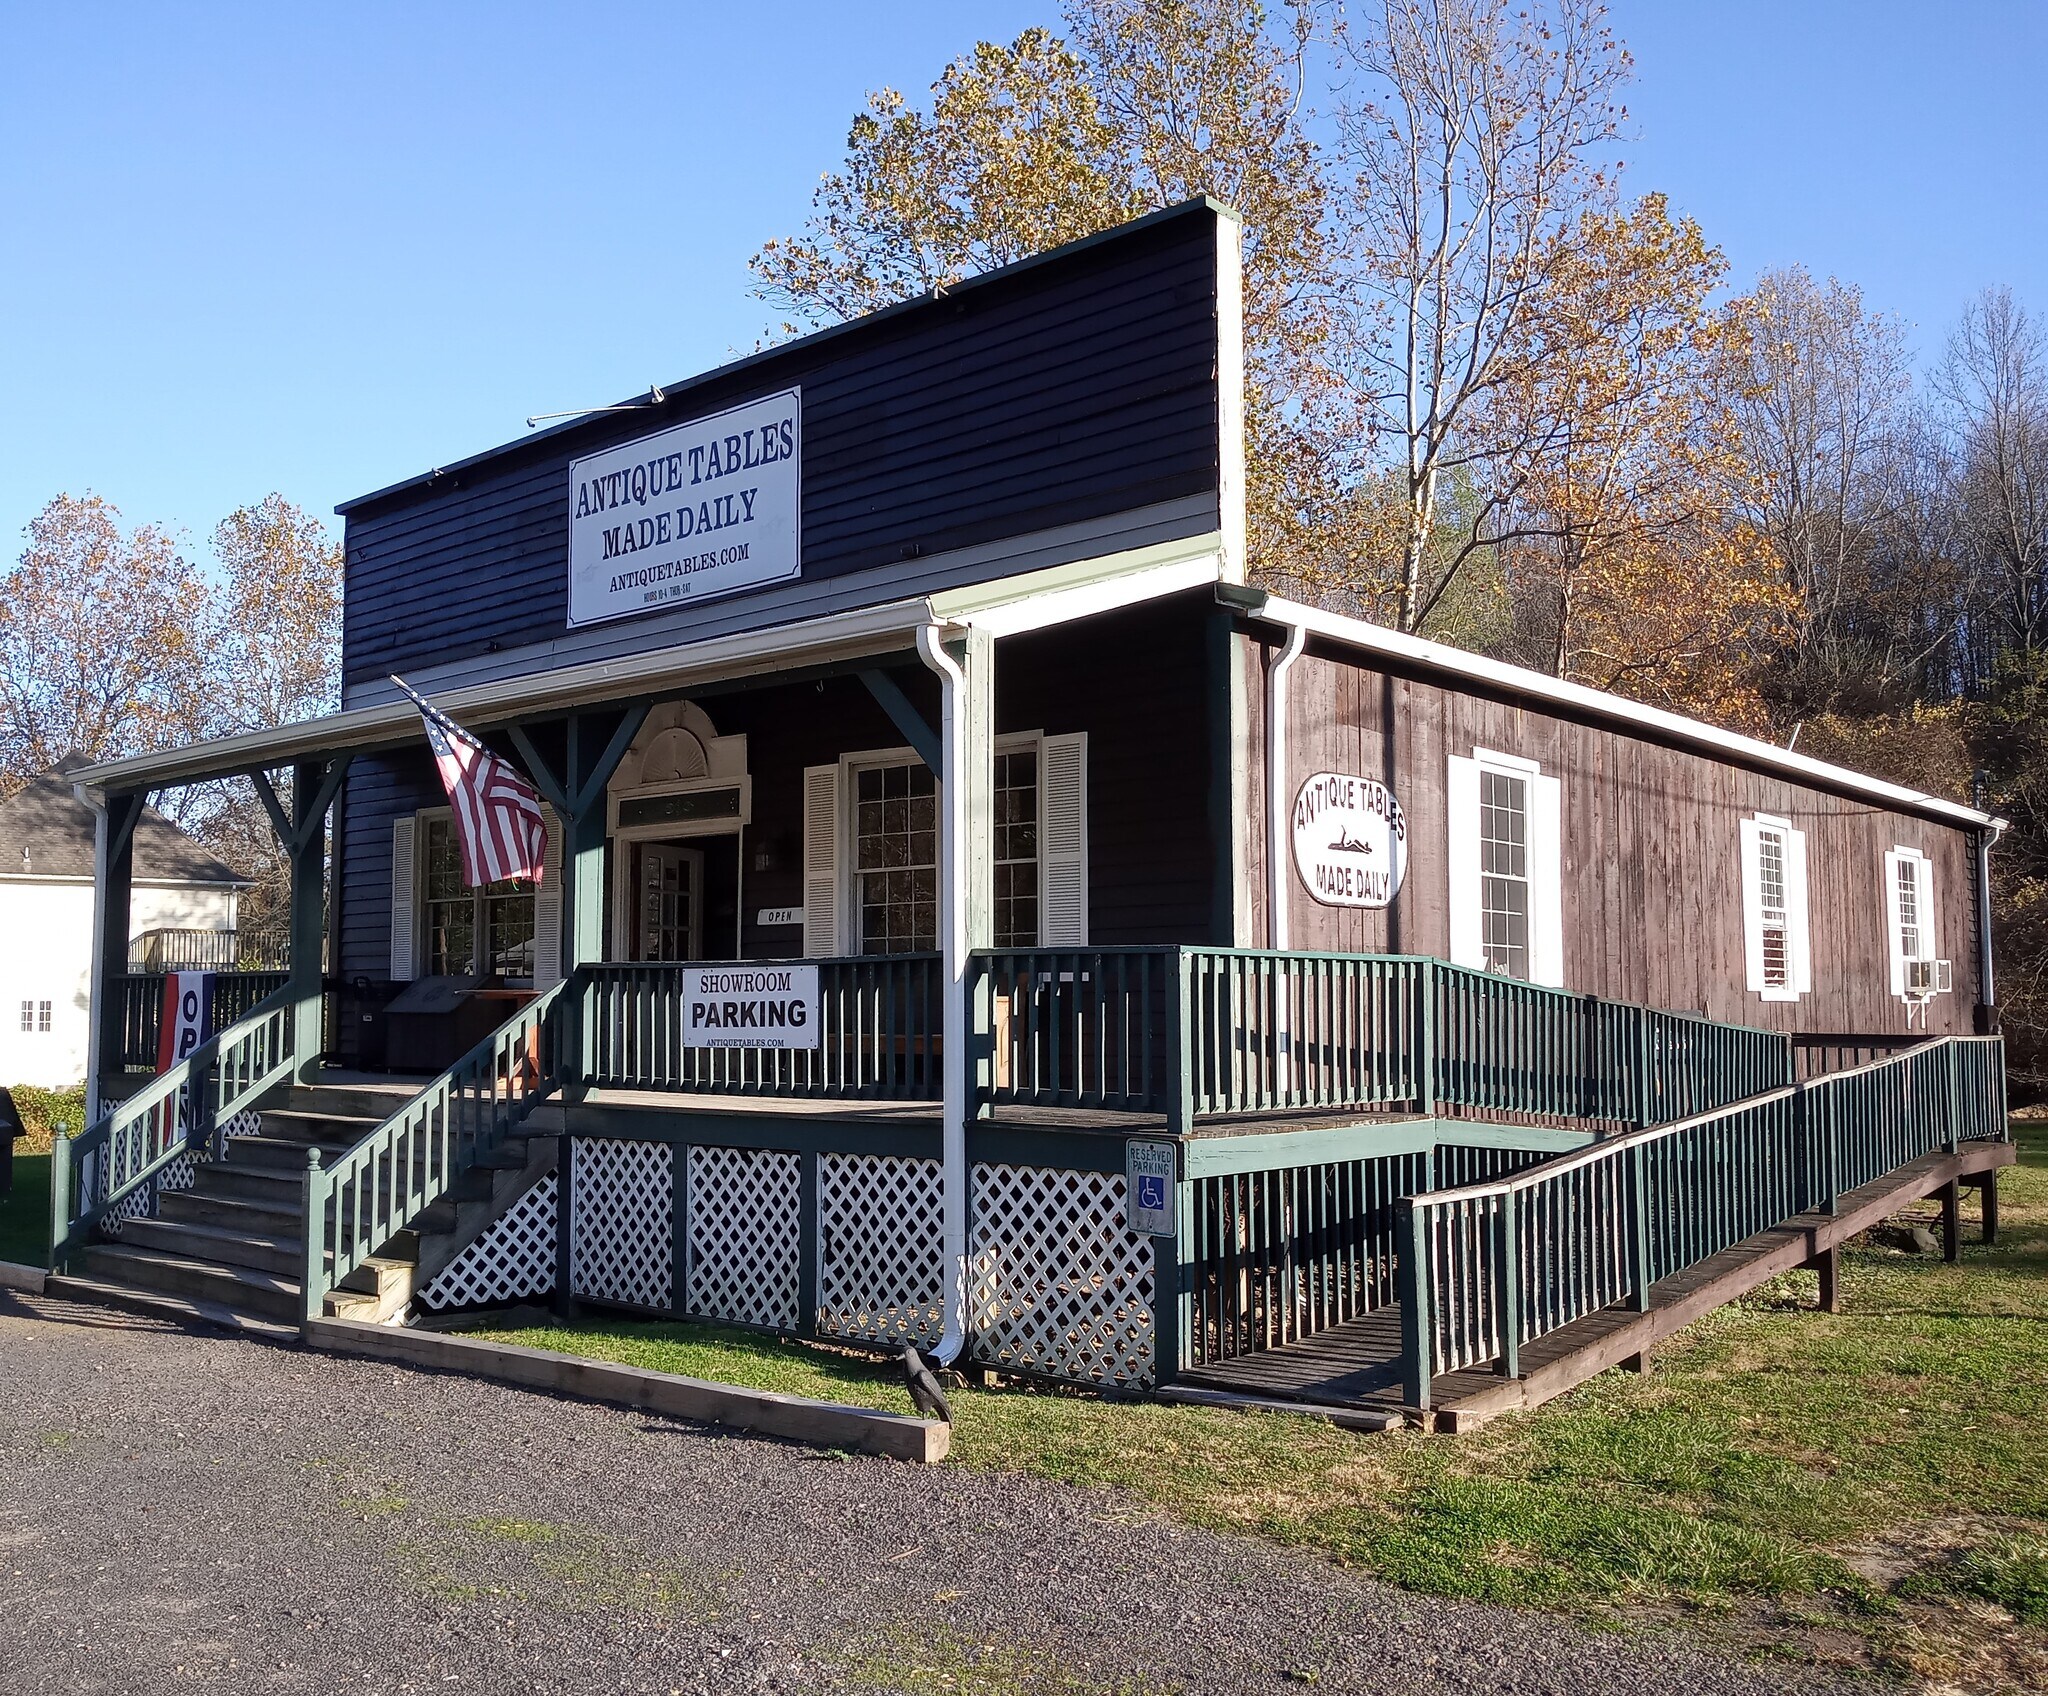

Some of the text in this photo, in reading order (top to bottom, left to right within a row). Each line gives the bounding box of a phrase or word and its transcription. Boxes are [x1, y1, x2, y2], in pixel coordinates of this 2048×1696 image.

[575, 417, 794, 519] ANTIQUE TABLES
[602, 488, 758, 560] MADE DAILY
[609, 542, 750, 593] ANTIQUETABLES.COM
[1297, 776, 1405, 841] ANTIQUE TABLES
[1316, 864, 1389, 901] MADE DAILY
[768, 911, 792, 922] OPEN
[700, 972, 792, 993] SHOWROOM
[692, 1000, 807, 1028] PARKING
[178, 990, 199, 1128] OPN
[706, 1039, 784, 1047] ANTIQUETABLES.COM
[1130, 1148, 1172, 1163] RESERVED
[1133, 1161, 1169, 1175] PARKING
